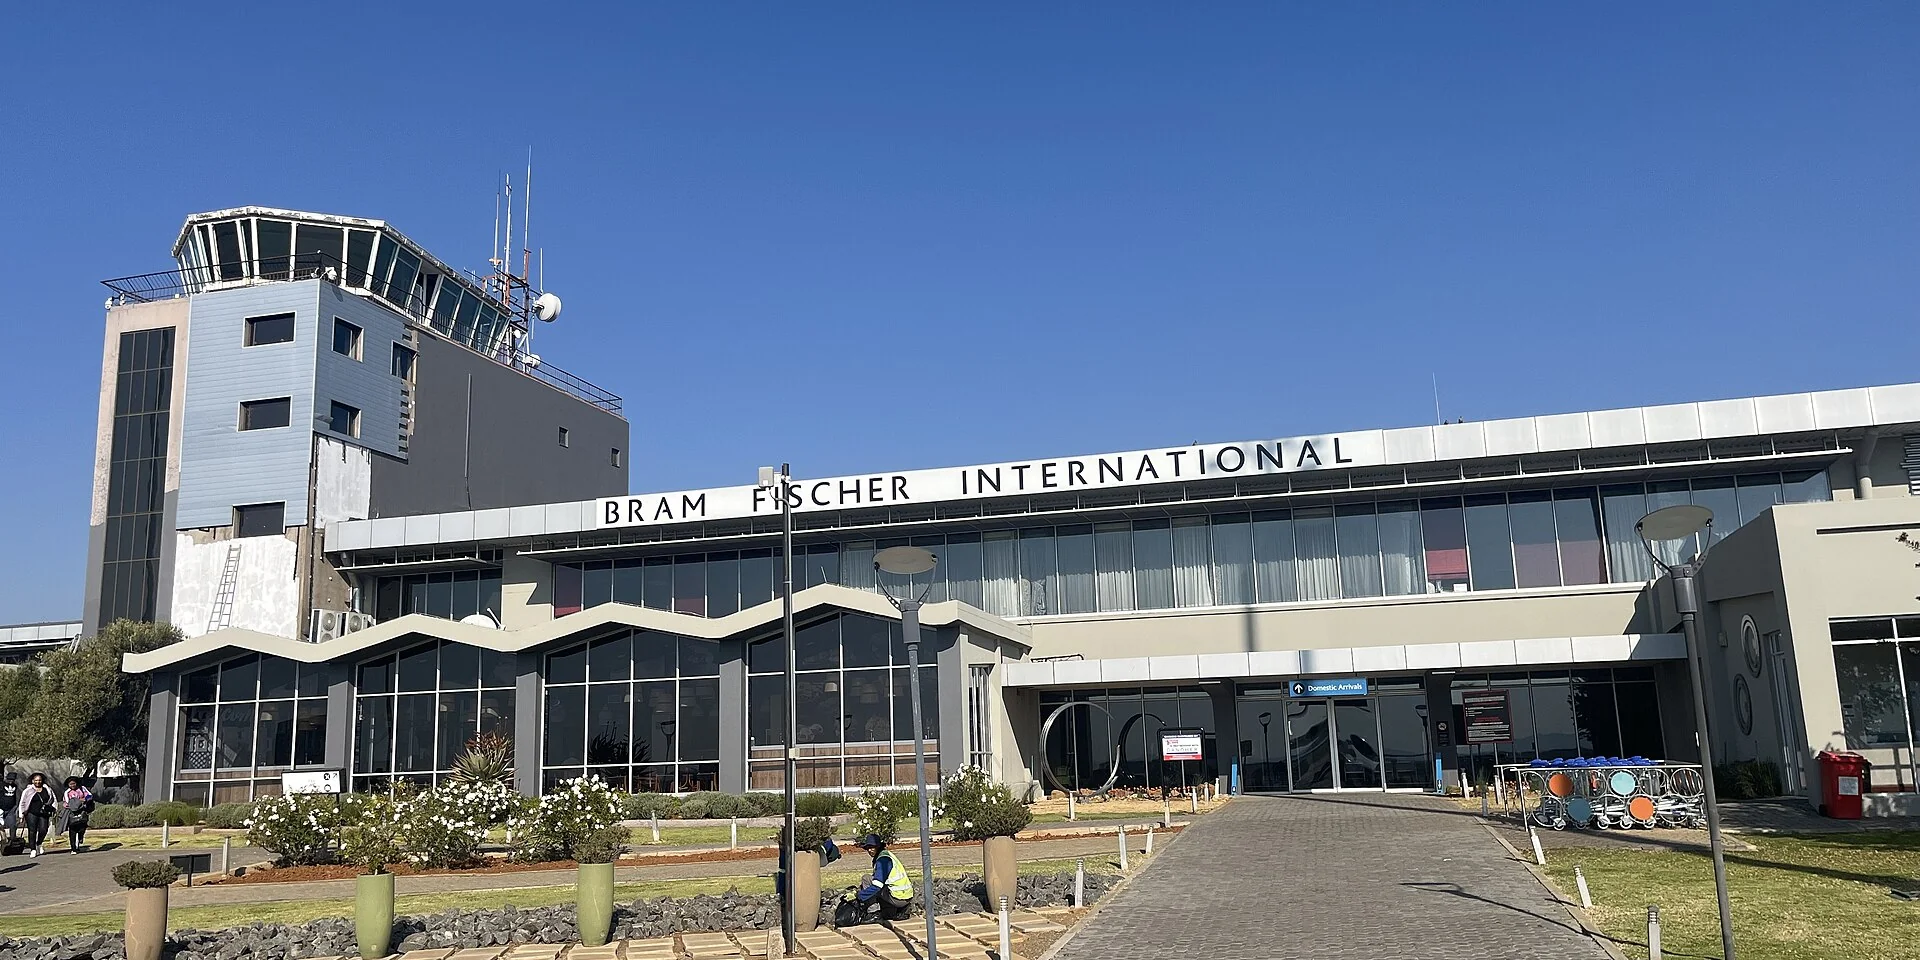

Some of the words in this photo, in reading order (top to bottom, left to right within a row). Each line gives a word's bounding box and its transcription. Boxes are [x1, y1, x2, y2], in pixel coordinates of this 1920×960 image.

[605, 493, 708, 525] BRAM
[753, 475, 910, 512] FISCHER
[962, 437, 1353, 495] INTERNATIONAL
